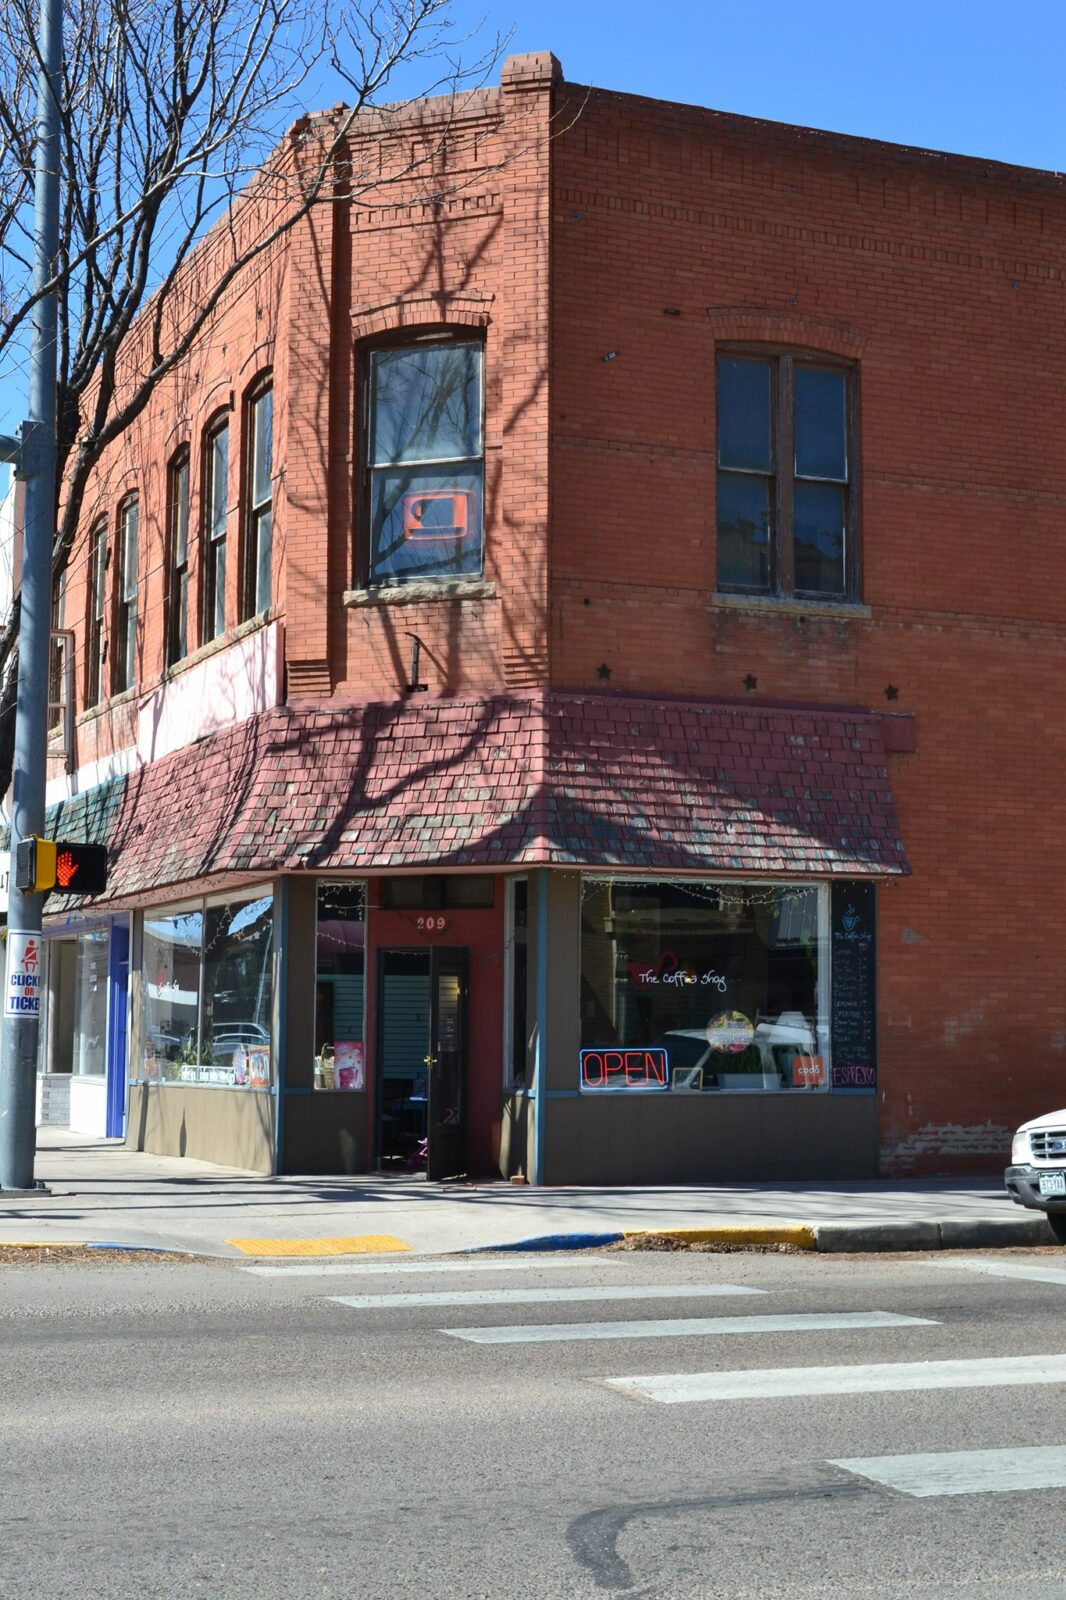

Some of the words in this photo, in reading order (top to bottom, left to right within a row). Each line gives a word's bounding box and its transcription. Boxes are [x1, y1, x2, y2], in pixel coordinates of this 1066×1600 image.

[417, 916, 446, 930] 209
[11, 974, 37, 987] CLICK
[639, 969, 660, 984] The
[24, 986, 35, 997] OR
[9, 996, 40, 1011] TICKE
[583, 1052, 665, 1087] OPEN
[833, 1065, 876, 1085] ESPRESSO
